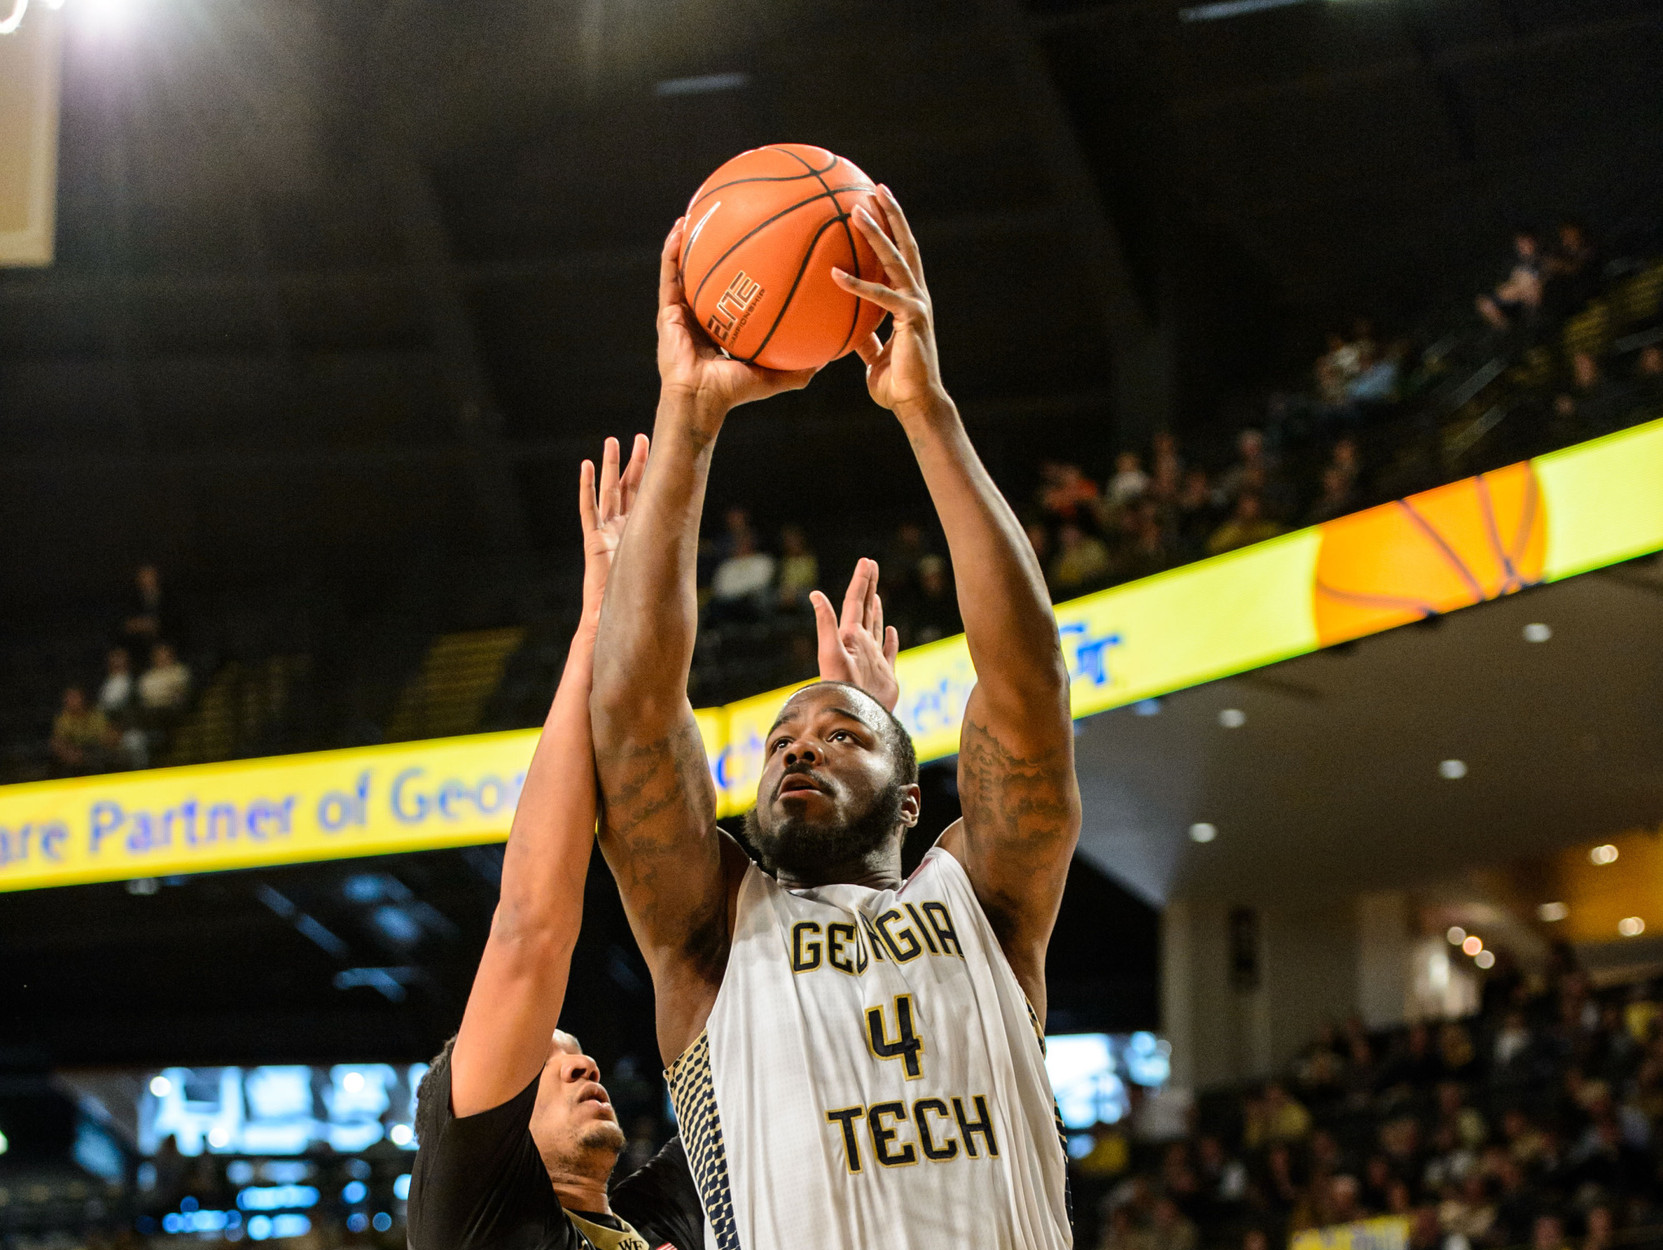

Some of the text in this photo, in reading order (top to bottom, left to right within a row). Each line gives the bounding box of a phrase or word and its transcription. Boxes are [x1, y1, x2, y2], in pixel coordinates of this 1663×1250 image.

[707, 270, 760, 342] ELITE
[729, 288, 766, 348] CHAMPIONSHIP
[90, 796, 295, 855] Partner
[317, 767, 378, 832] of
[389, 766, 526, 823] Geor
[790, 901, 966, 977] GEORGIA
[865, 993, 925, 1082] 4
[825, 1094, 1000, 1175] TECH
